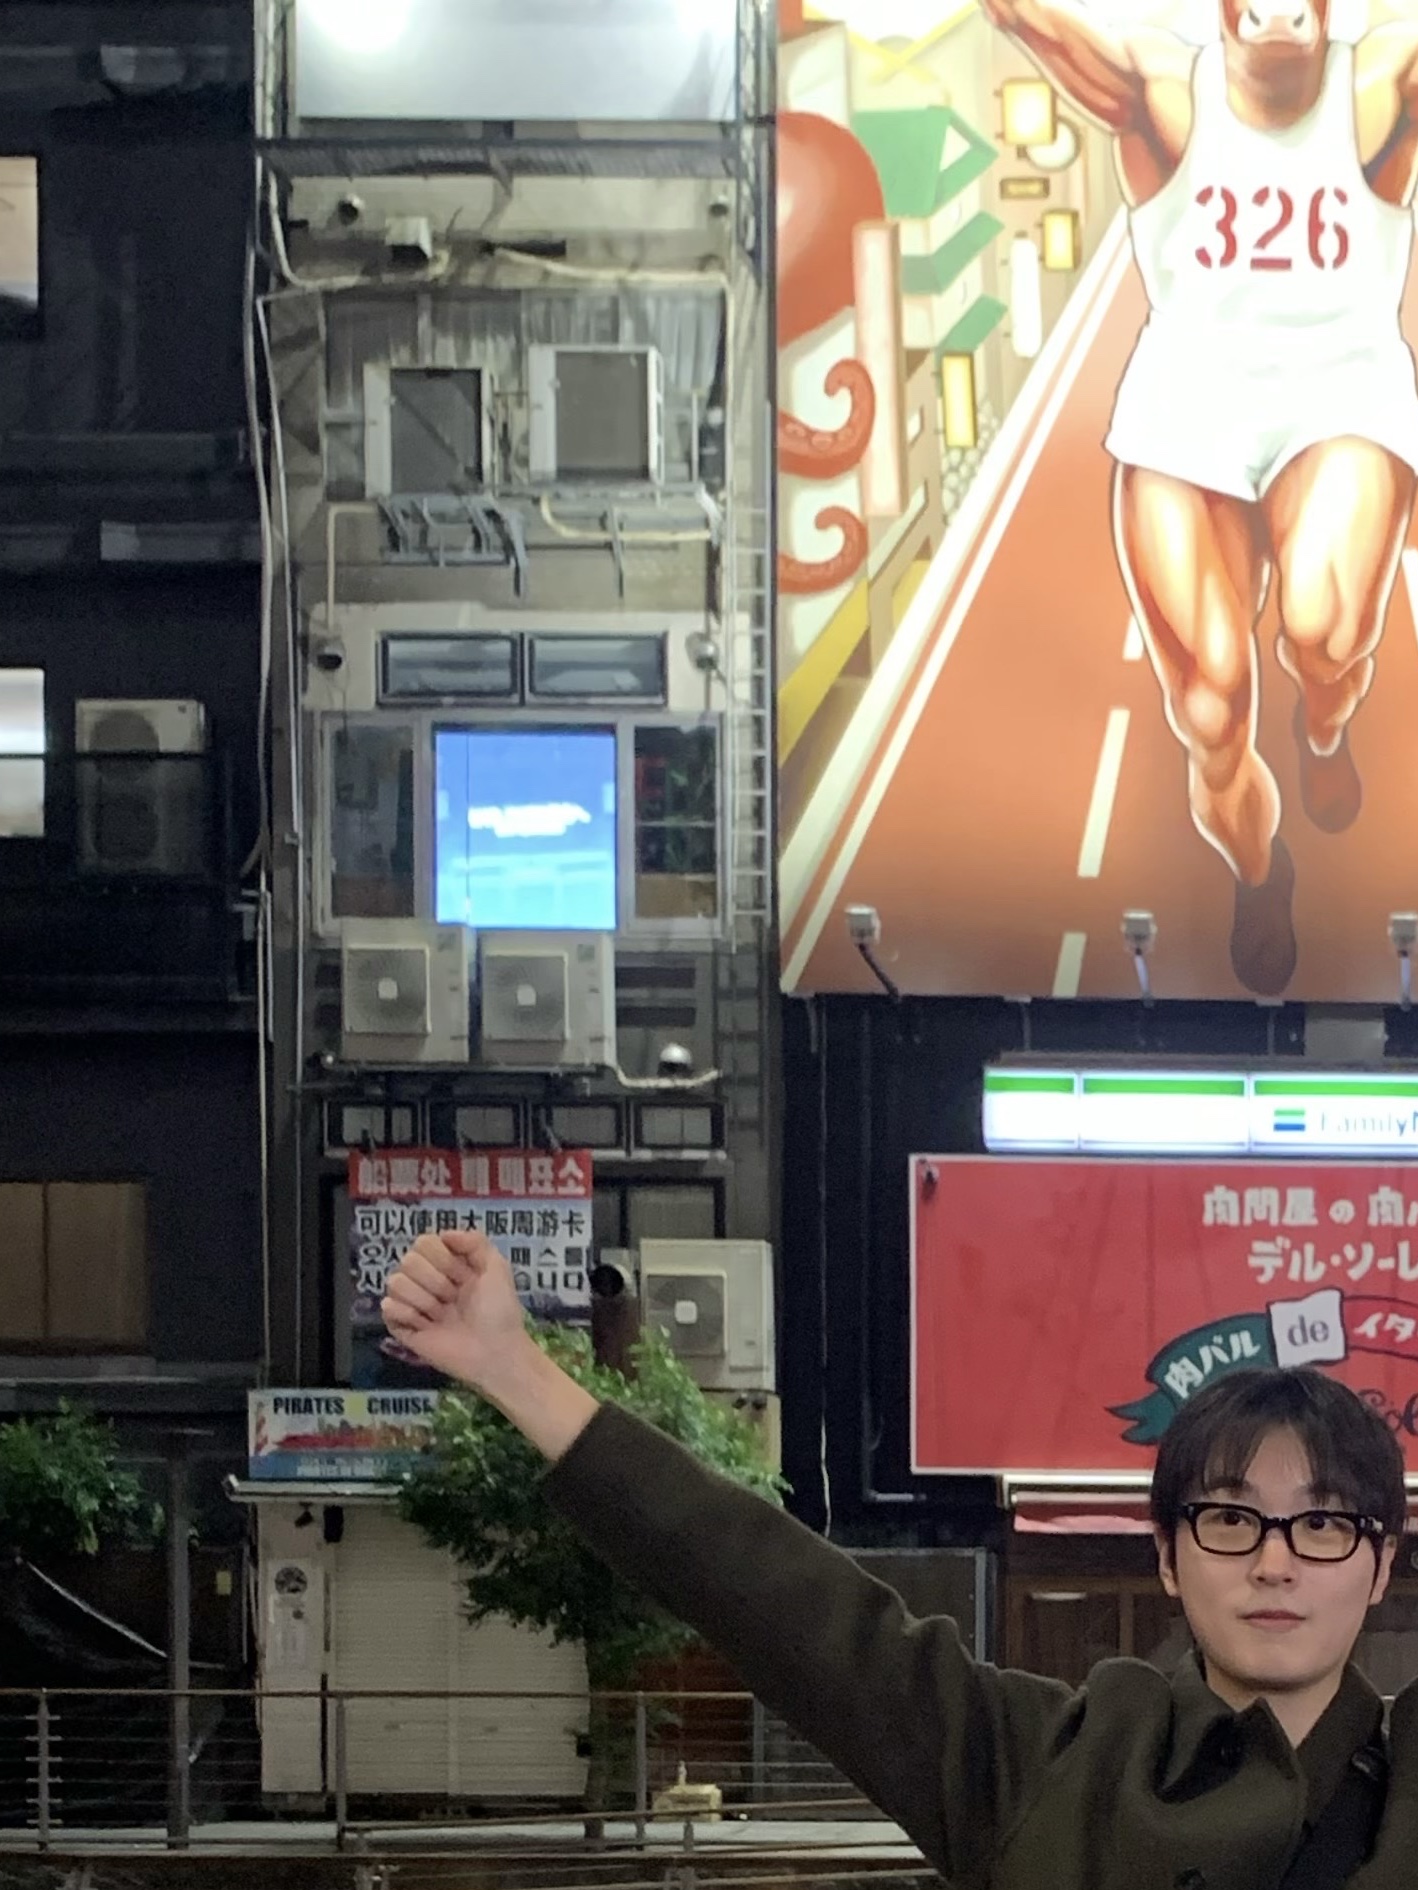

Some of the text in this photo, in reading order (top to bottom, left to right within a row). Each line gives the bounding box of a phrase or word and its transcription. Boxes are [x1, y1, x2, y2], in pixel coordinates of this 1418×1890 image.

[1194, 185, 1349, 271] 326
[357, 1207, 585, 1238] 可以使用大阪周游卡
[1163, 1329, 1262, 1399] 肉バル
[1286, 1315, 1330, 1348] de
[272, 1396, 345, 1415] PIRATES
